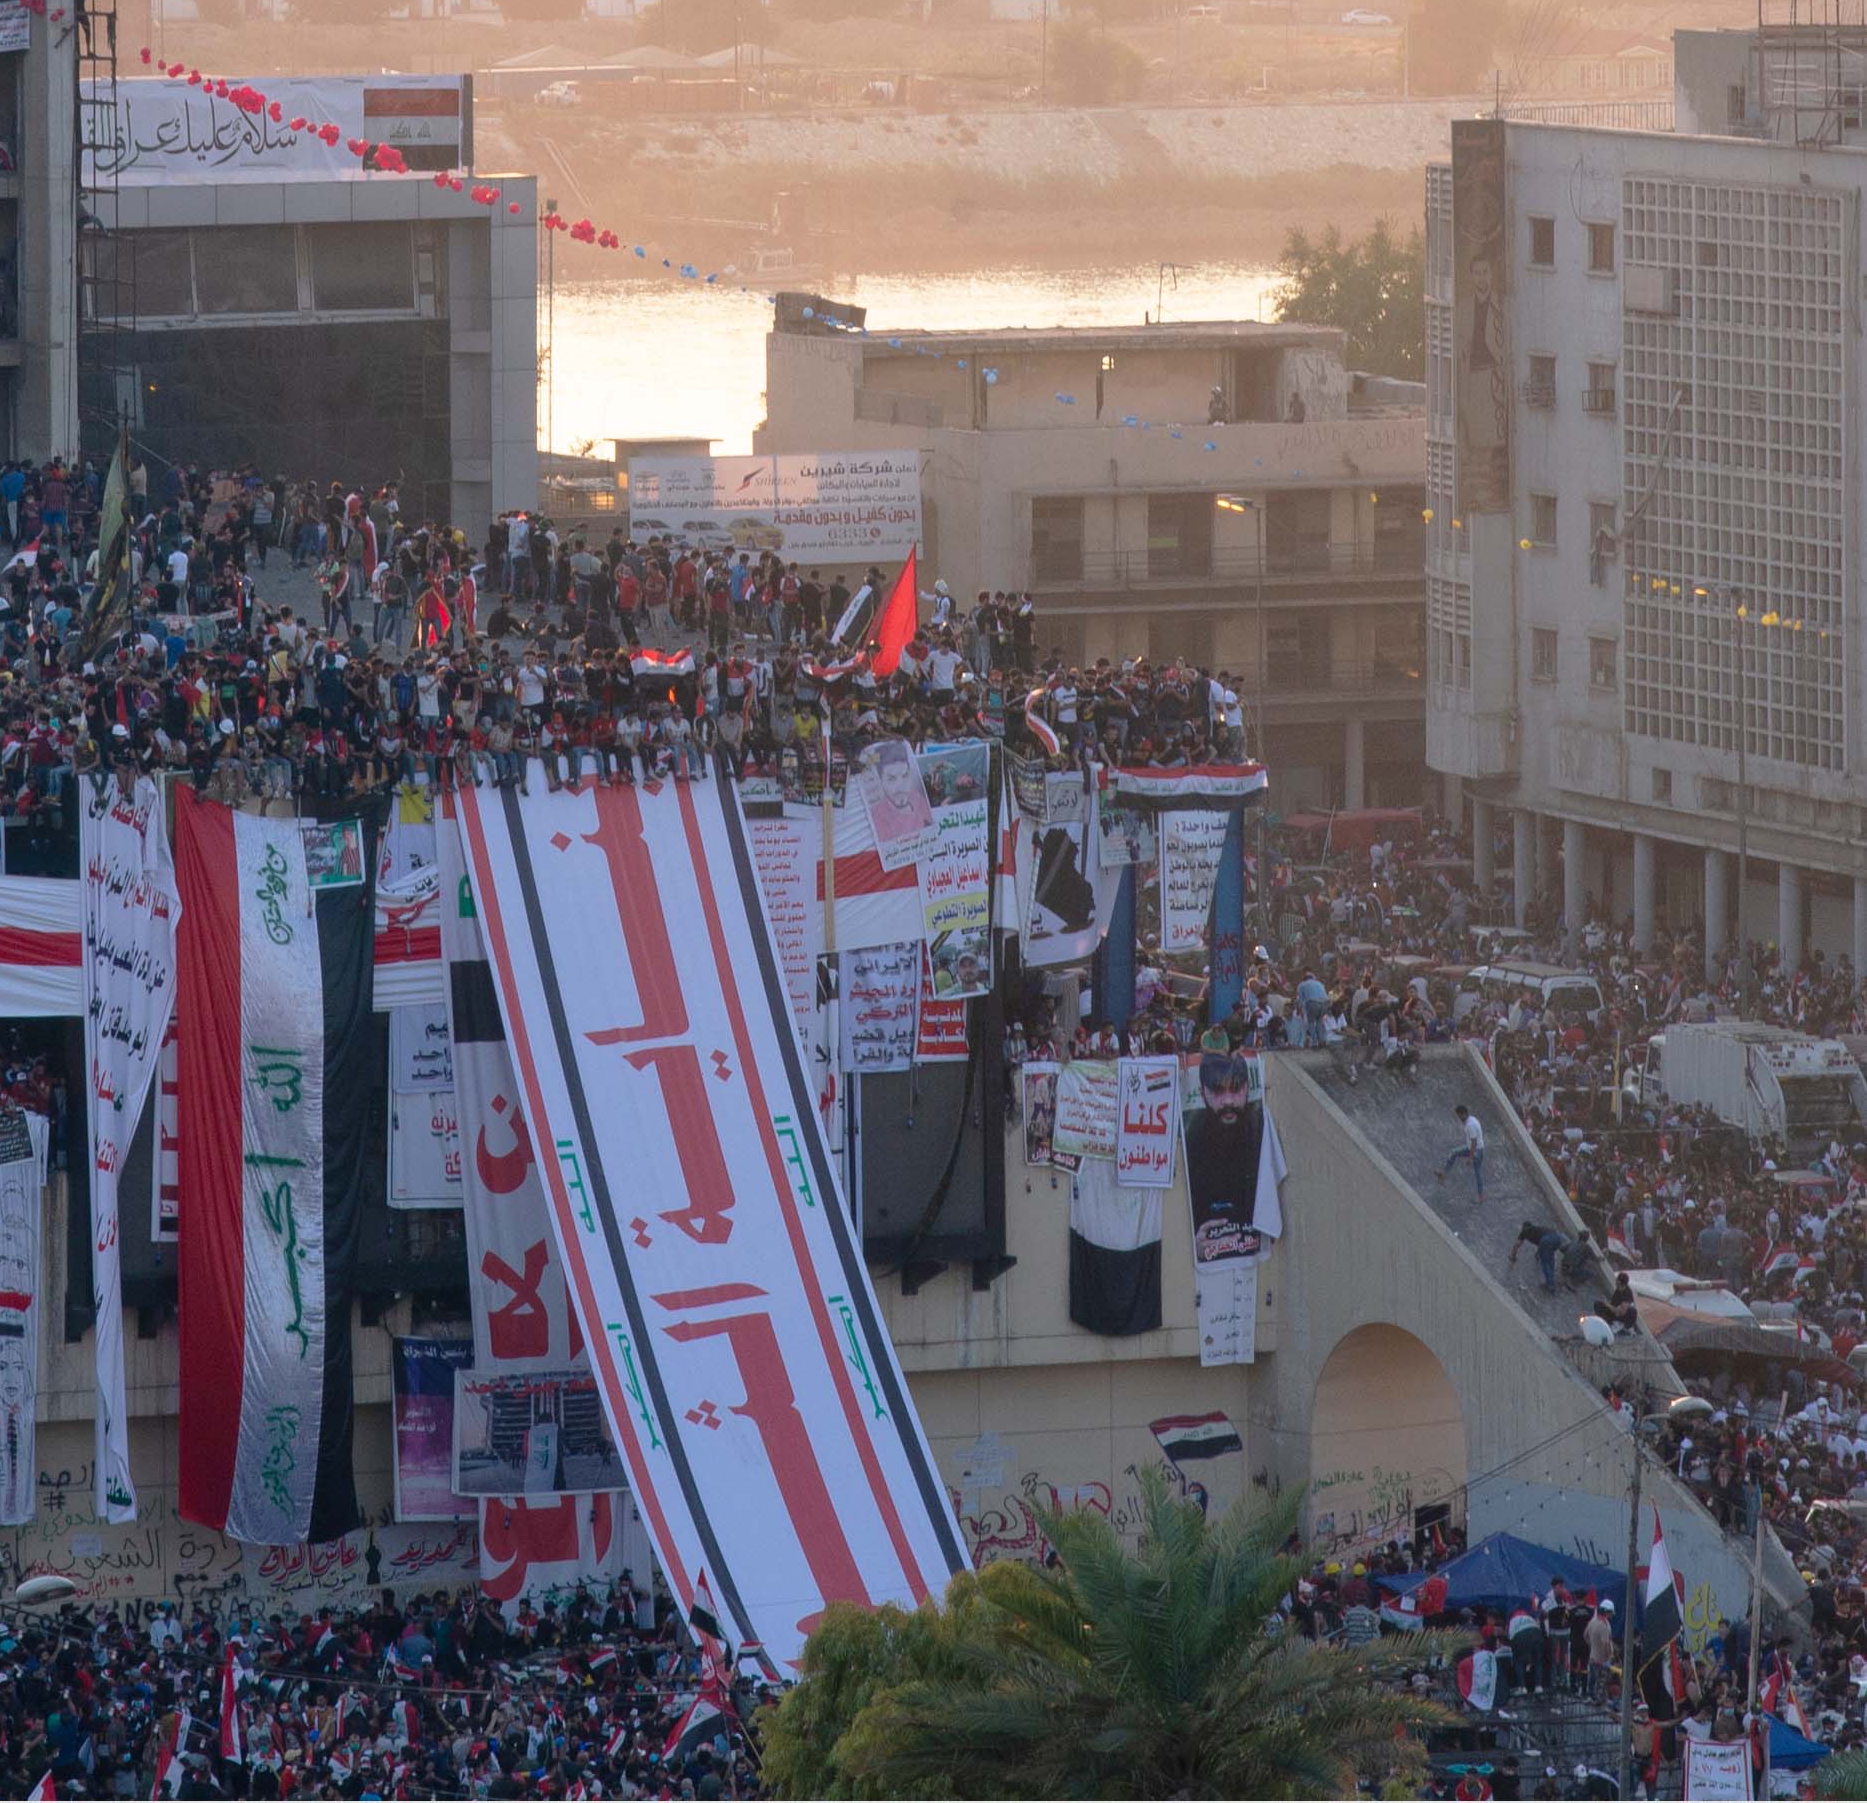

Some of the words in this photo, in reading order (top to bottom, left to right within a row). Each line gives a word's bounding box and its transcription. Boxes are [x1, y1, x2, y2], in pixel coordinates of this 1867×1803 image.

[799, 461, 846, 479] شيرين
[849, 460, 894, 474] شركة
[773, 510, 814, 526] مقدمة
[814, 510, 843, 526] بدون
[850, 508, 887, 525] كفيل
[887, 509, 917, 524] بدون
[854, 1004, 914, 1024] التركي
[1123, 1101, 1170, 1136] كلنا
[1118, 1144, 1169, 1173] مواطنون
[772, 1113, 818, 1210] الله
[827, 1294, 892, 1422] اكبر
[552, 1137, 599, 1236] الله
[605, 1322, 671, 1457] اكبر
